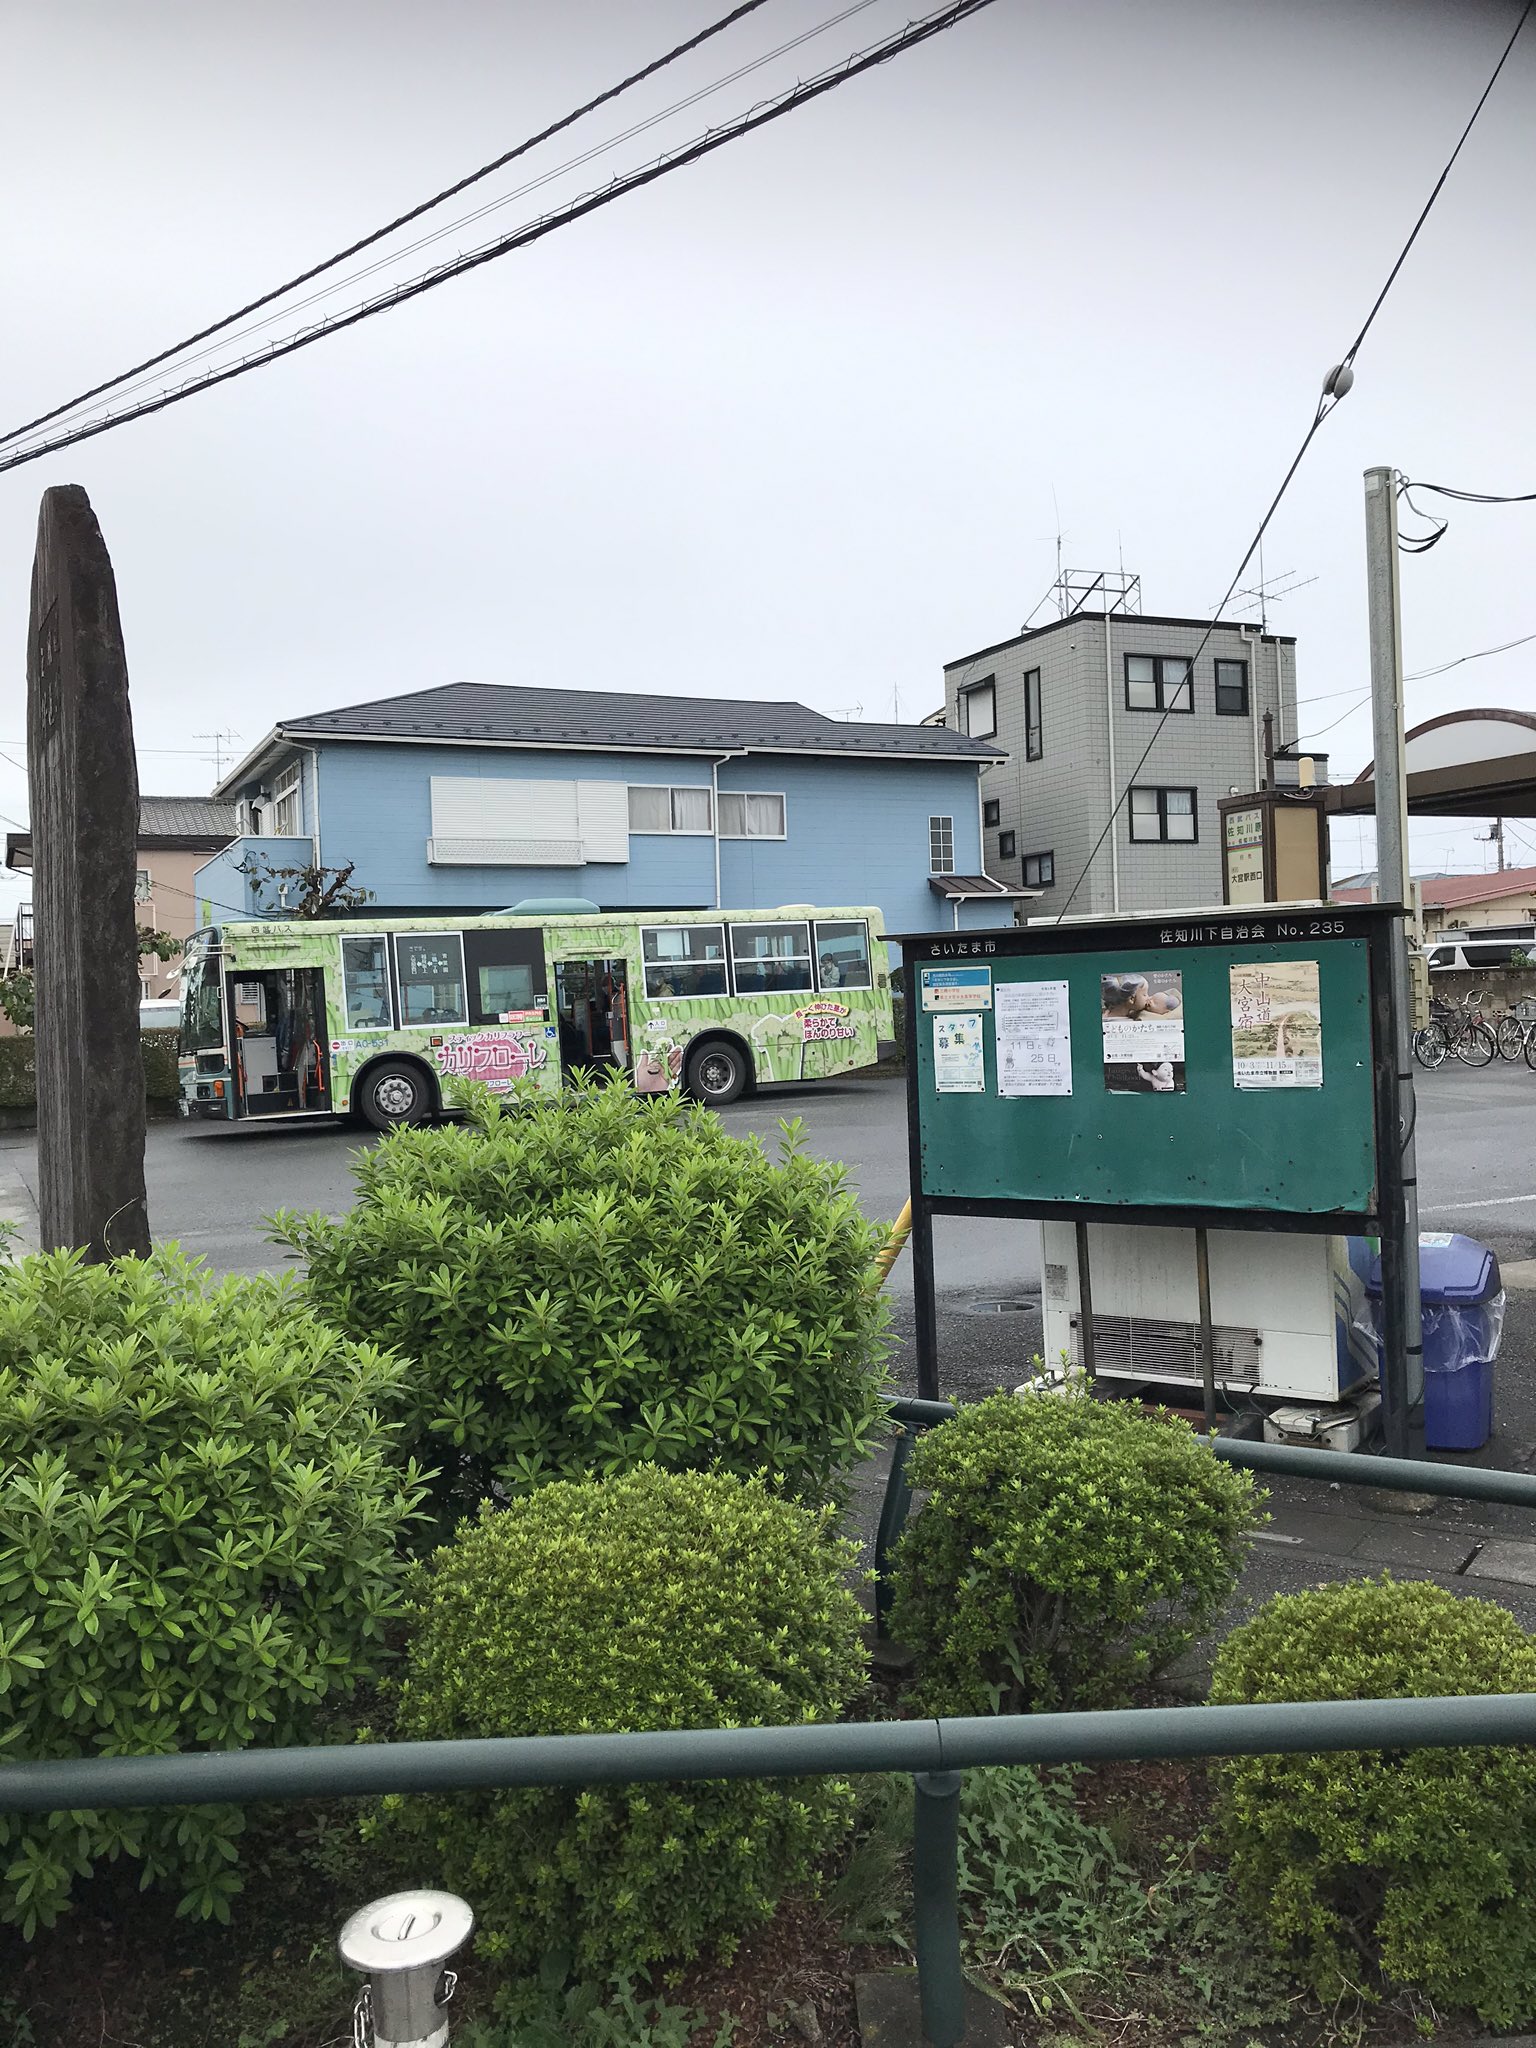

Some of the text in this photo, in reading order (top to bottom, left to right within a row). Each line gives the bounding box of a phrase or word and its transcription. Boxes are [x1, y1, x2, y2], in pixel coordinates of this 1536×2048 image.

[1231, 871, 1263, 884] 大宮駅西口
[1160, 924, 1265, 944] 佐知川下自治会
[930, 940, 997, 956] さいたま市
[1237, 979, 1254, 1030] 大宮宿
[1255, 972, 1271, 1024] 中山道
[804, 1027, 853, 1039] ほんのり甘い
[938, 1018, 977, 1034] スタッフ
[938, 1033, 965, 1049] 募集
[437, 1040, 546, 1077] カリフローレ
